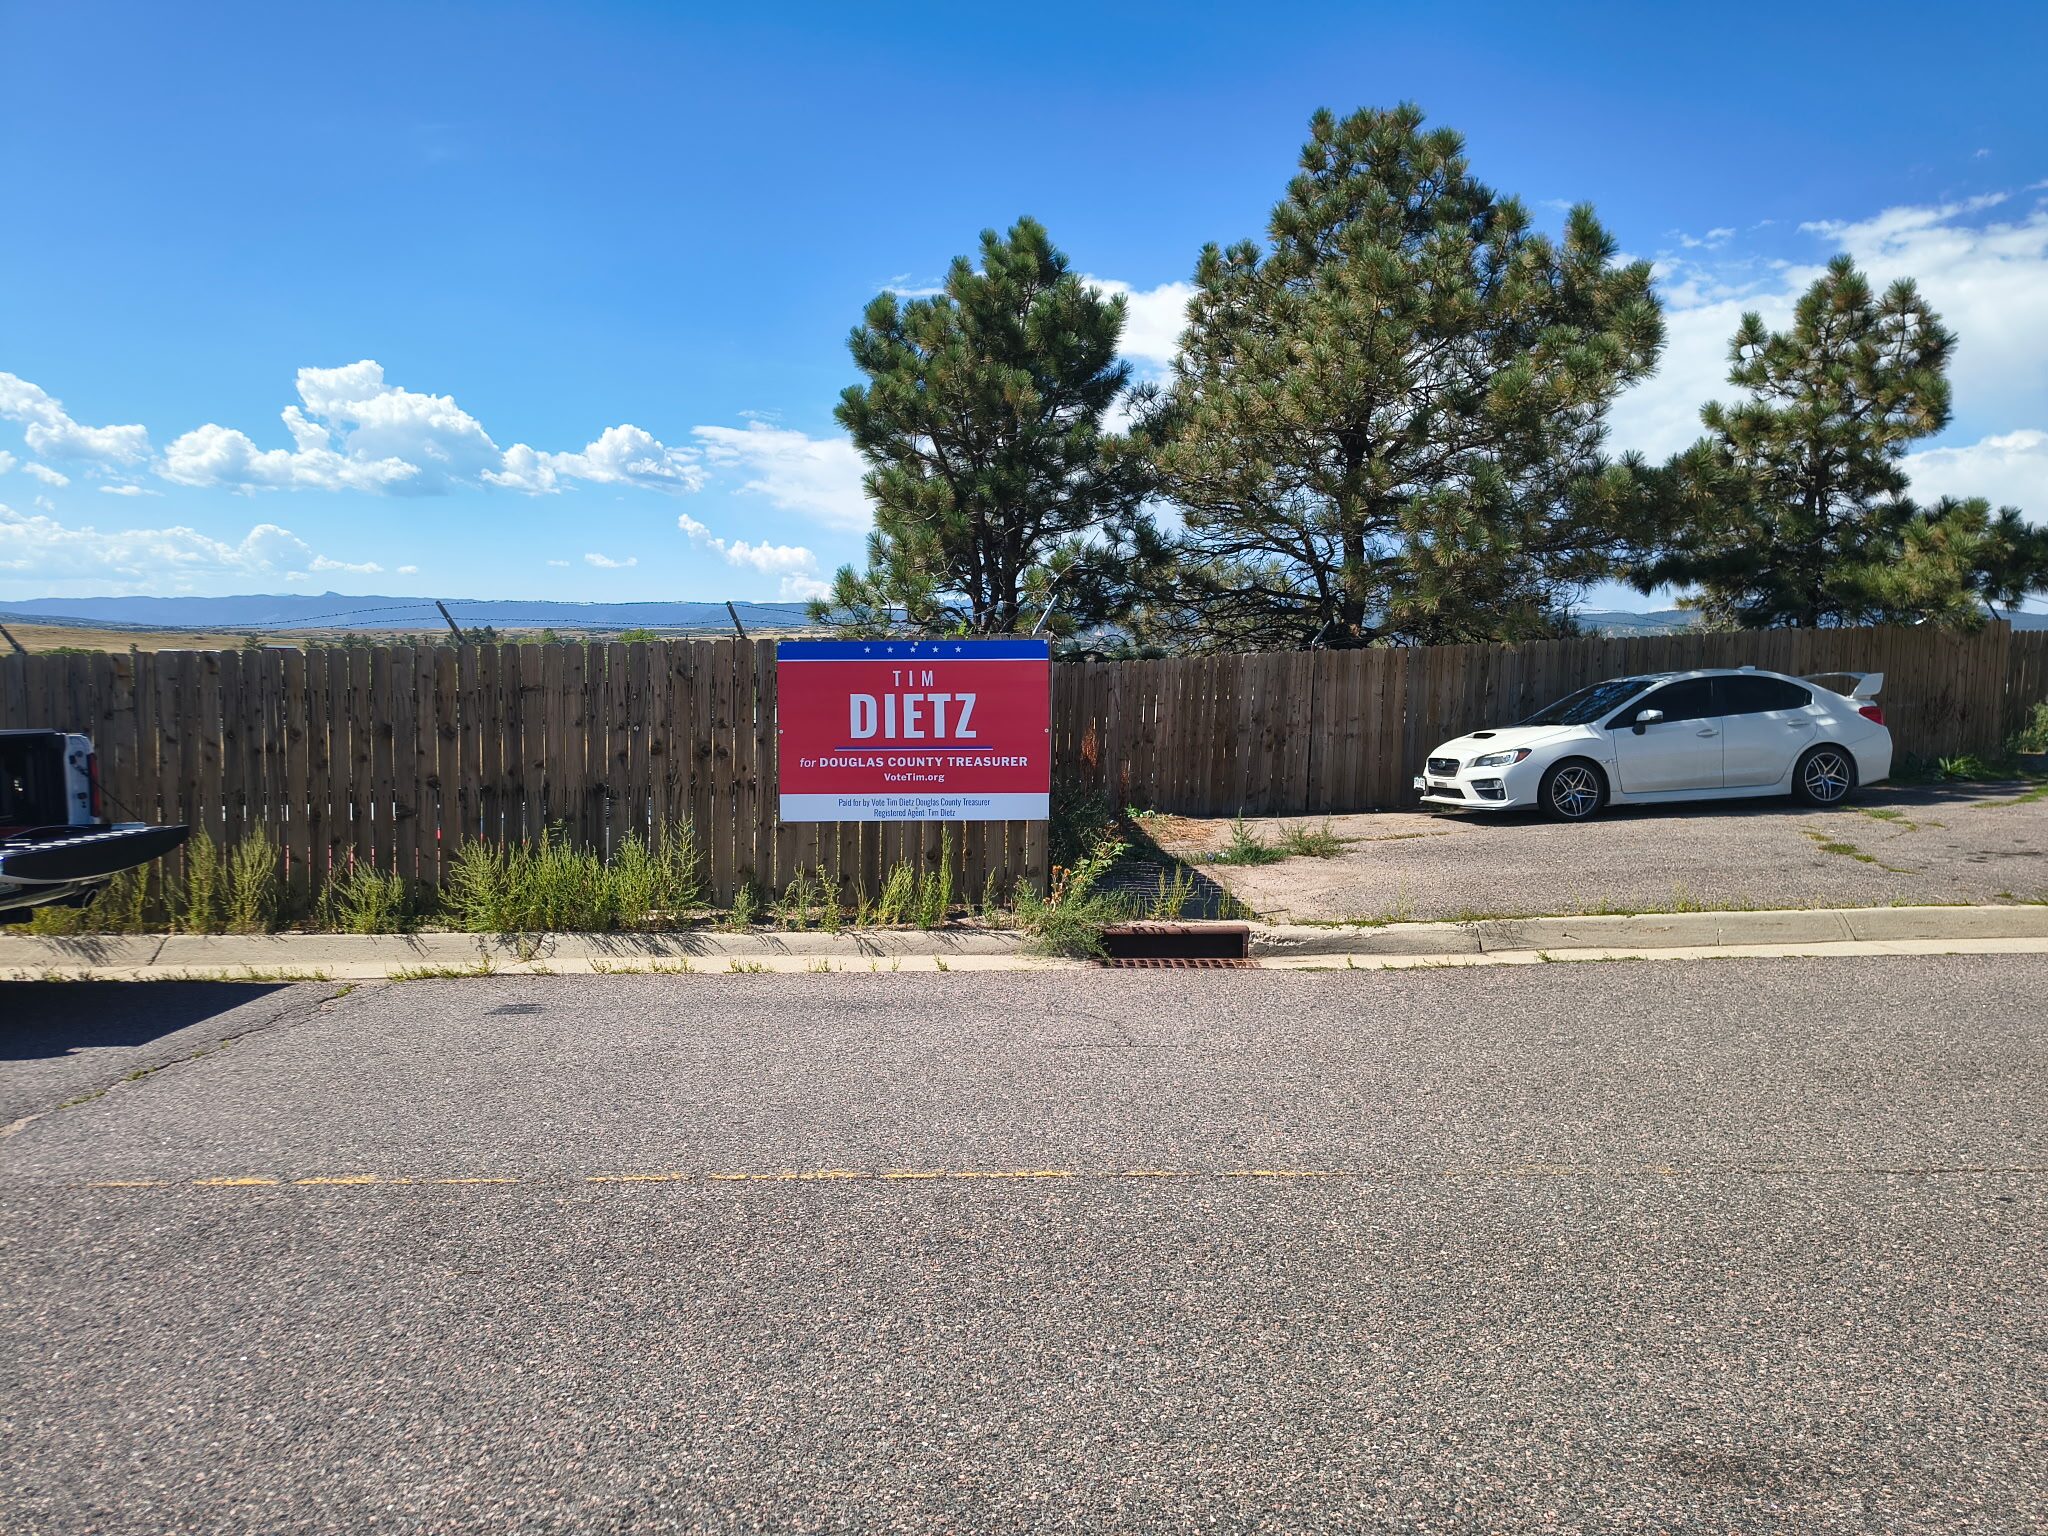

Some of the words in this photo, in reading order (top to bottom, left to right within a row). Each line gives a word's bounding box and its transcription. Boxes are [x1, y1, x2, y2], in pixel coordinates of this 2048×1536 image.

[893, 670, 934, 687] TIM
[850, 692, 977, 739] DIETZ
[800, 757, 816, 768] for
[819, 757, 884, 768] DOUGLAS
[888, 756, 943, 768] COUNTY
[947, 756, 1028, 767] TREASURER
[884, 772, 945, 783] VoteTim.org
[838, 798, 852, 807] Paid
[853, 798, 861, 806] for
[863, 798, 870, 808] by
[871, 798, 885, 807] Vote
[886, 798, 898, 806] Tim
[899, 797, 914, 806] Dietz
[915, 797, 939, 807] Douglas
[940, 797, 962, 807] County
[963, 797, 990, 806] Treasurer
[928, 808, 939, 817] Tim
[940, 808, 956, 817] Dietz
